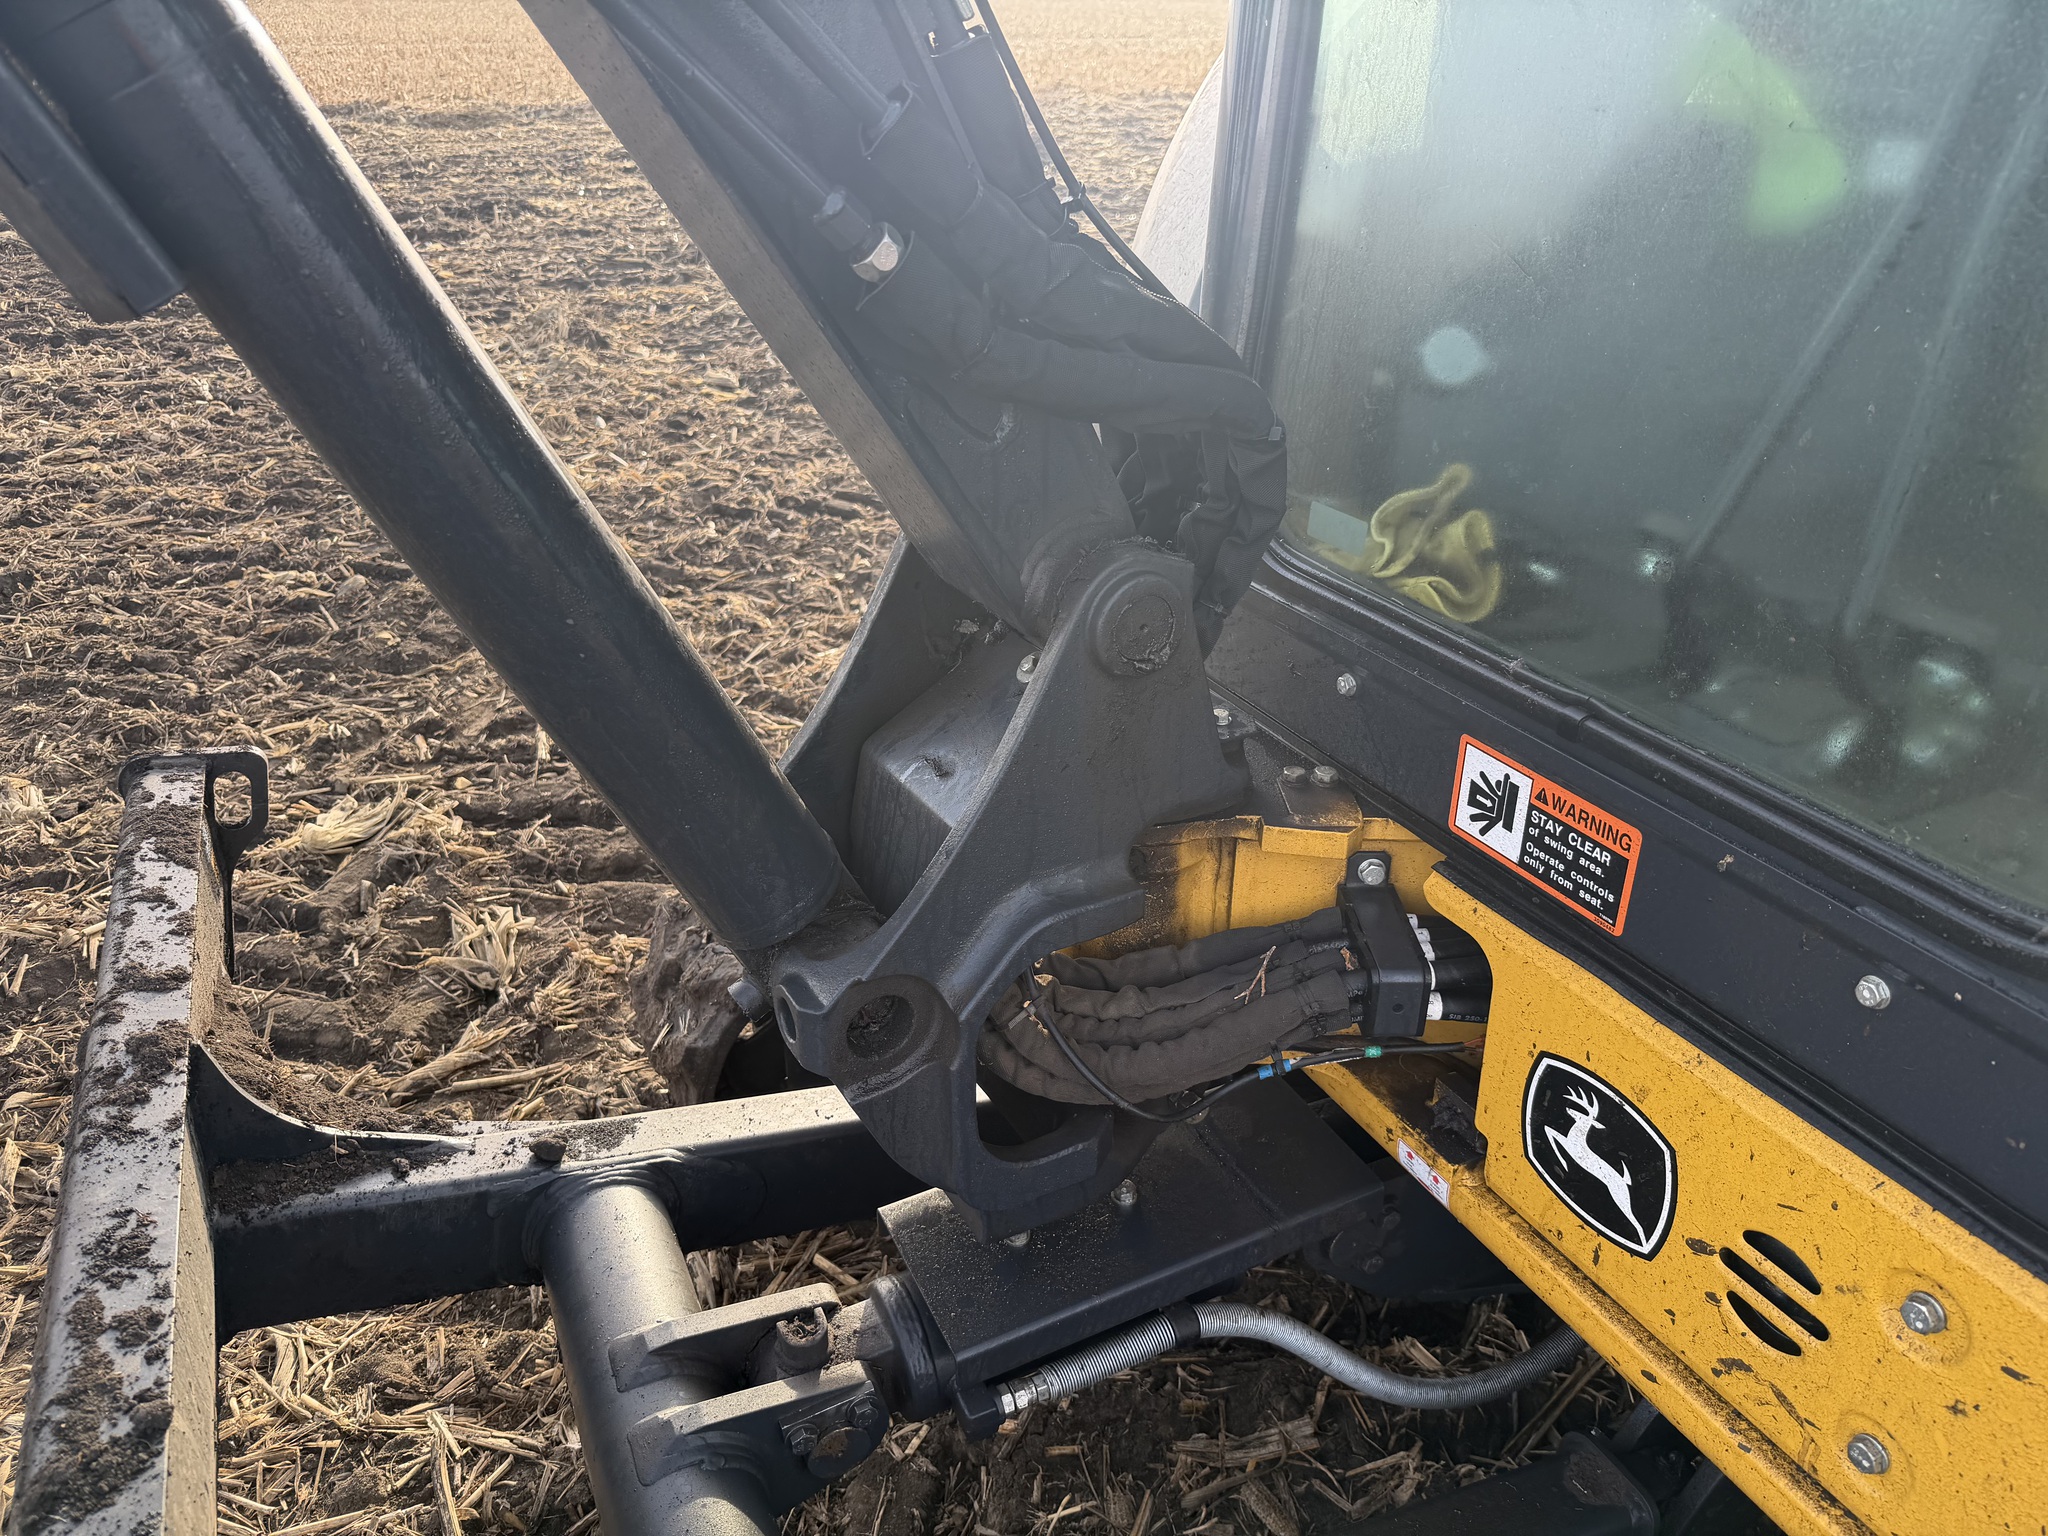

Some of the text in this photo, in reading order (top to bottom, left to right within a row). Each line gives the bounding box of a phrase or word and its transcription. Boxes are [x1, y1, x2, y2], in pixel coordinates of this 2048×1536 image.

[1531, 811, 1611, 866] STAY CLEAR
[1552, 792, 1632, 853] WARNING
[1526, 843, 1614, 902] Operate controls
[1529, 827, 1604, 877] of swing area.
[1524, 856, 1603, 910] only from seat.
